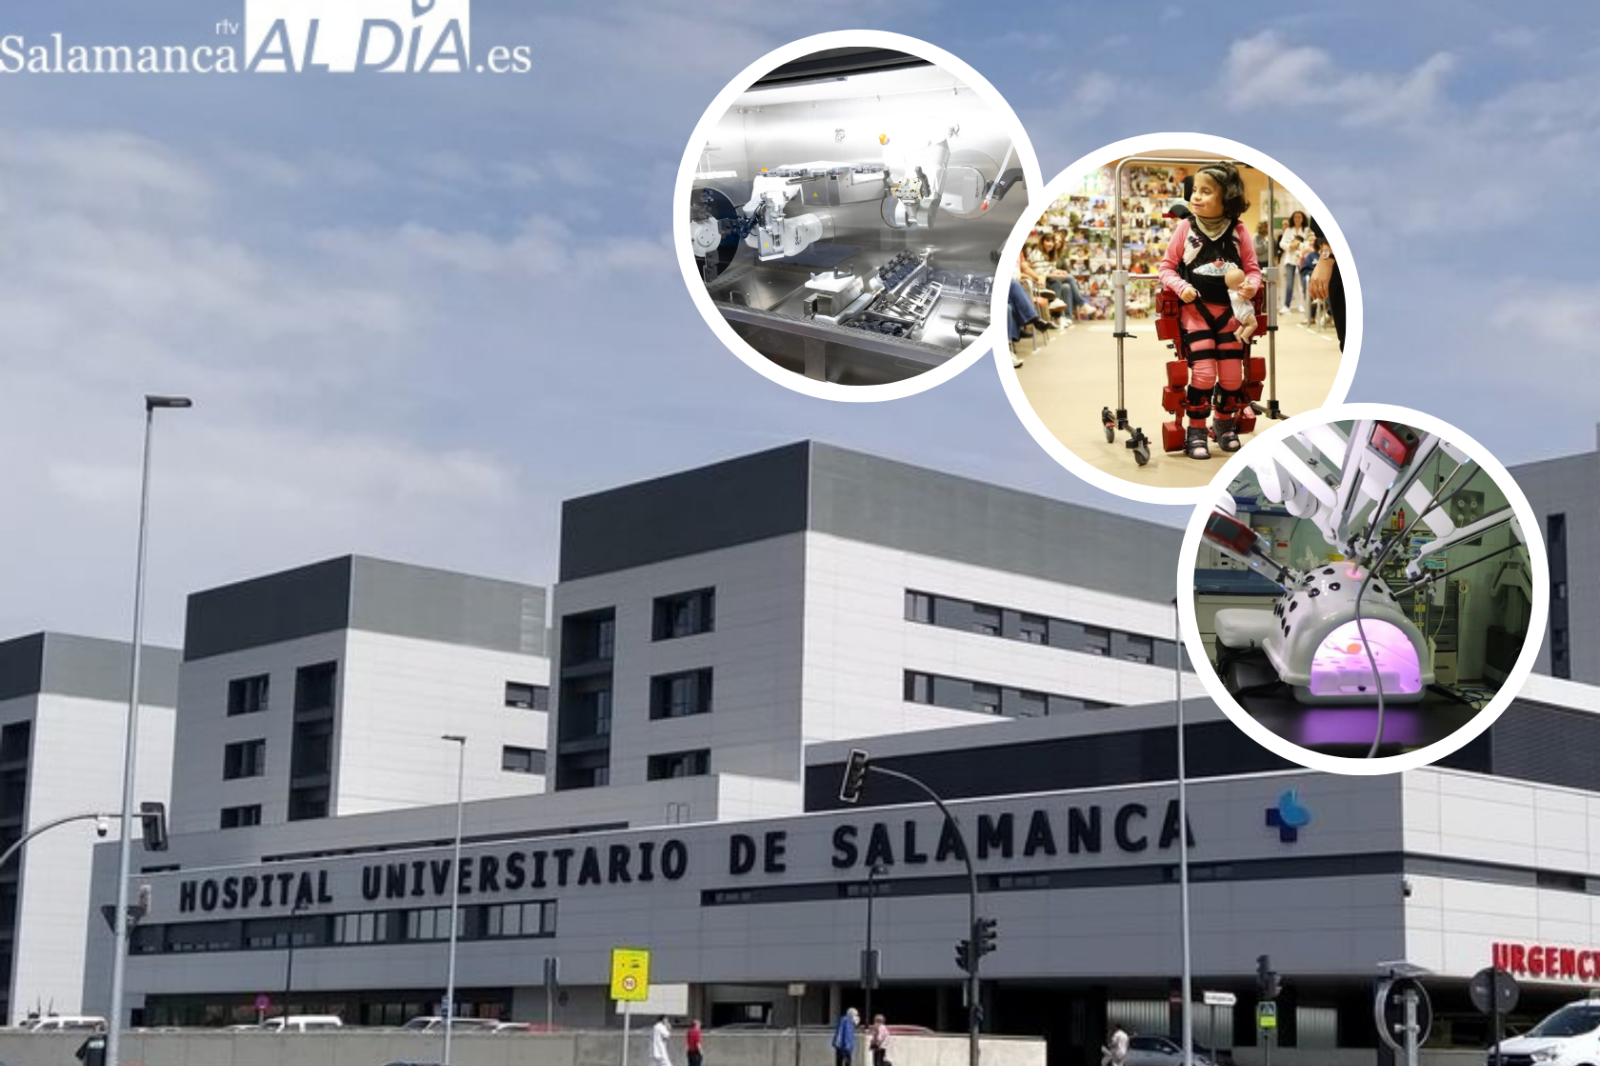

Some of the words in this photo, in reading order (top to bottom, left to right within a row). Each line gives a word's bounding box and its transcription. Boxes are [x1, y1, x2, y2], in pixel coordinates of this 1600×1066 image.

[180, 870, 332, 912] HOSPITAL
[362, 840, 688, 900] UNIVERSITARIO
[730, 831, 787, 876] DE
[832, 799, 1196, 868] SALAMANCA
